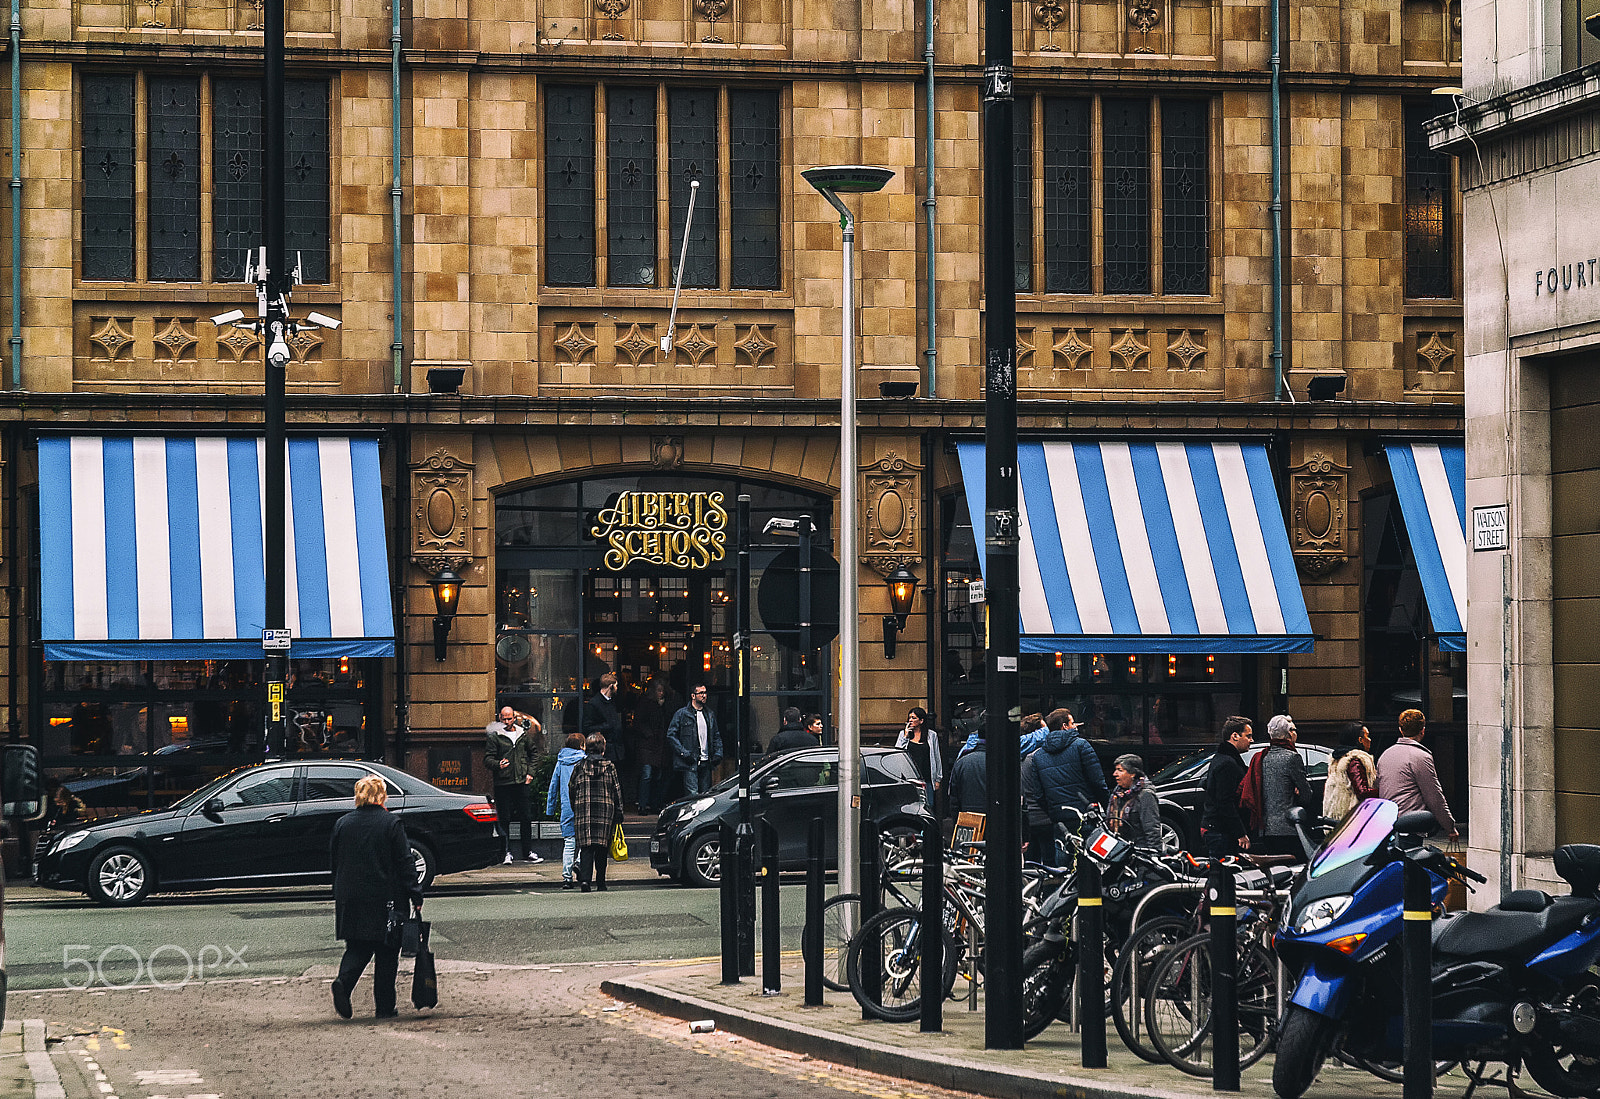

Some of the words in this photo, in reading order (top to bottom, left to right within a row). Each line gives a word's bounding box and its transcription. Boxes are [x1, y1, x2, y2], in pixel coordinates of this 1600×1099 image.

[1535, 257, 1600, 297] FOURT
[1476, 510, 1506, 528] WATSON
[1478, 529, 1504, 546] STREET
[604, 527, 726, 571] SCHLOSS
[265, 631, 273, 640] P
[1092, 834, 1108, 857] L
